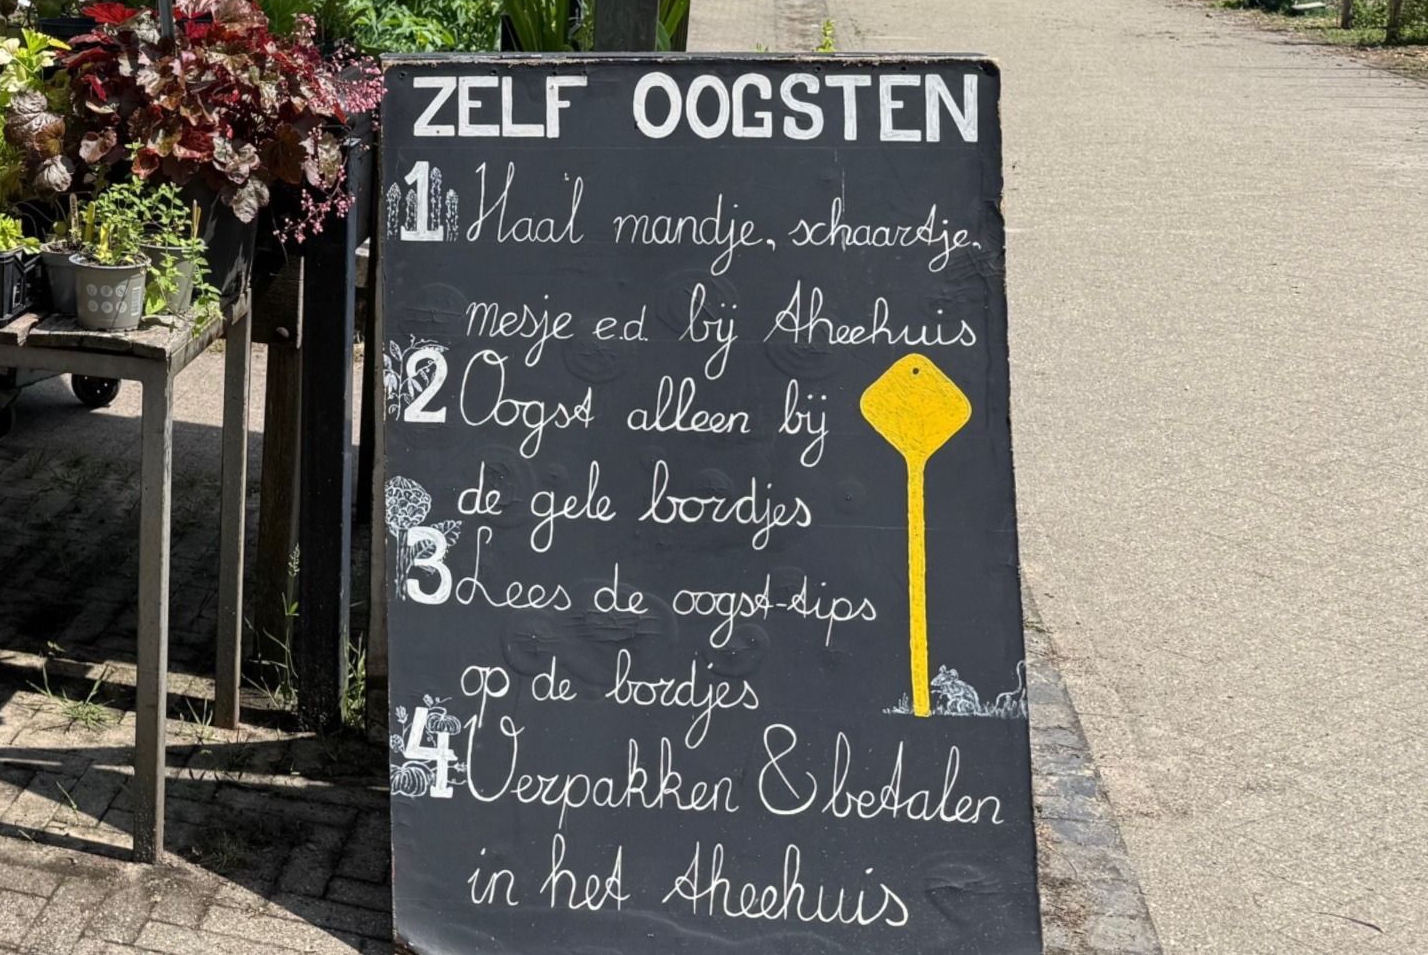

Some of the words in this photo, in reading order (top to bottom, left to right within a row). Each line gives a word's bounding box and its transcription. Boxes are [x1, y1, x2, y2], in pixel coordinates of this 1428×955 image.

[413, 76, 587, 138] ZELF
[633, 72, 978, 142] OOGSTEN
[400, 161, 444, 241] 1
[467, 162, 583, 243] Haal
[613, 194, 775, 275] mandje,
[466, 295, 573, 366] mesje
[679, 283, 738, 380] bij
[402, 349, 448, 423] 2
[461, 350, 592, 457] Oogst
[627, 375, 750, 433] alleen
[779, 379, 828, 467] bij
[458, 461, 502, 515] de
[530, 460, 616, 552] gele
[639, 459, 811, 549] bordjes
[407, 526, 453, 604] 3
[456, 526, 571, 611] Lees
[594, 563, 648, 614] de
[673, 574, 876, 648] oogst-tips
[461, 666, 510, 728] op
[532, 656, 577, 701] de
[605, 649, 759, 749] bordjes
[405, 707, 455, 798] 4
[463, 715, 739, 829] Verpakken
[759, 724, 817, 815] &
[822, 732, 1004, 824] betalen
[468, 848, 518, 906] in
[540, 833, 630, 910] het
[662, 842, 908, 926] theehuis
